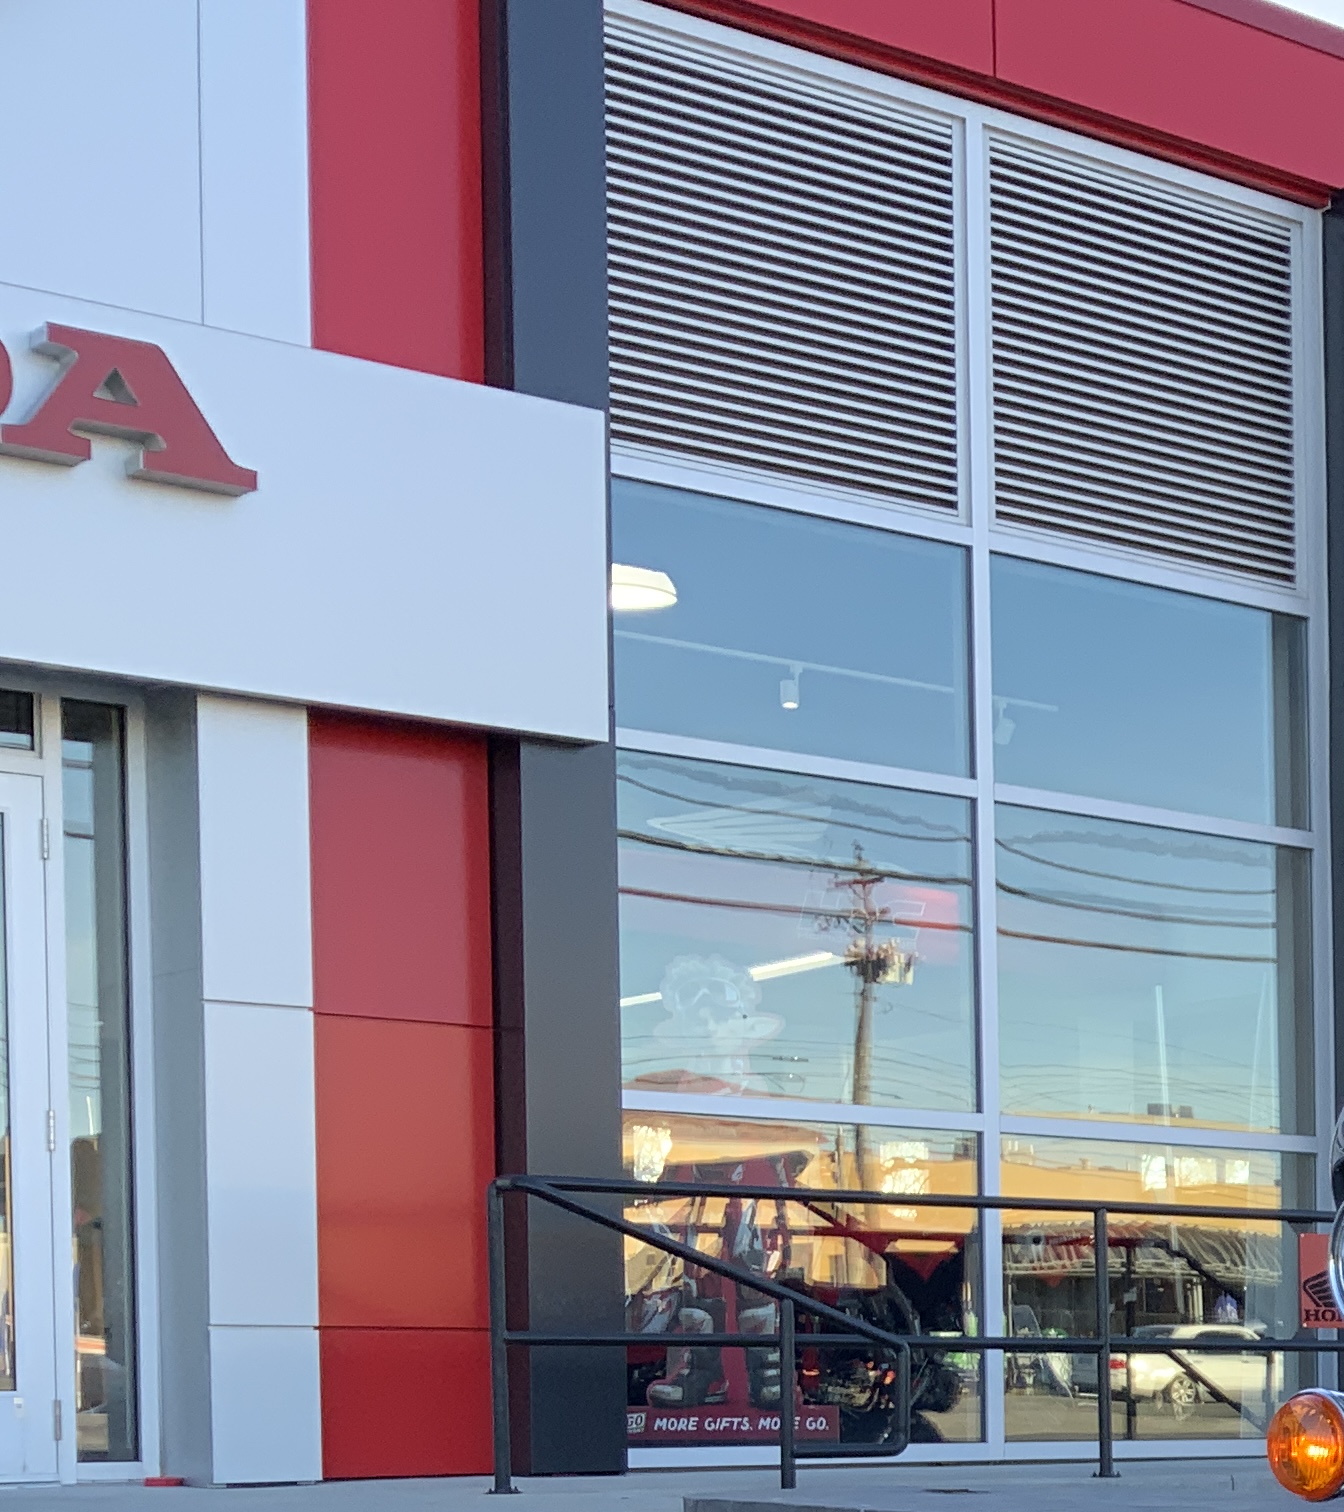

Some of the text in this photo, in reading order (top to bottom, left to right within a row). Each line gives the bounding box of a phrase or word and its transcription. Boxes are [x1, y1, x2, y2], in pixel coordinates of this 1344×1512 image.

[0, 322, 257, 496] A
[654, 1417, 699, 1431] MORE
[806, 1417, 829, 1431] GO.
